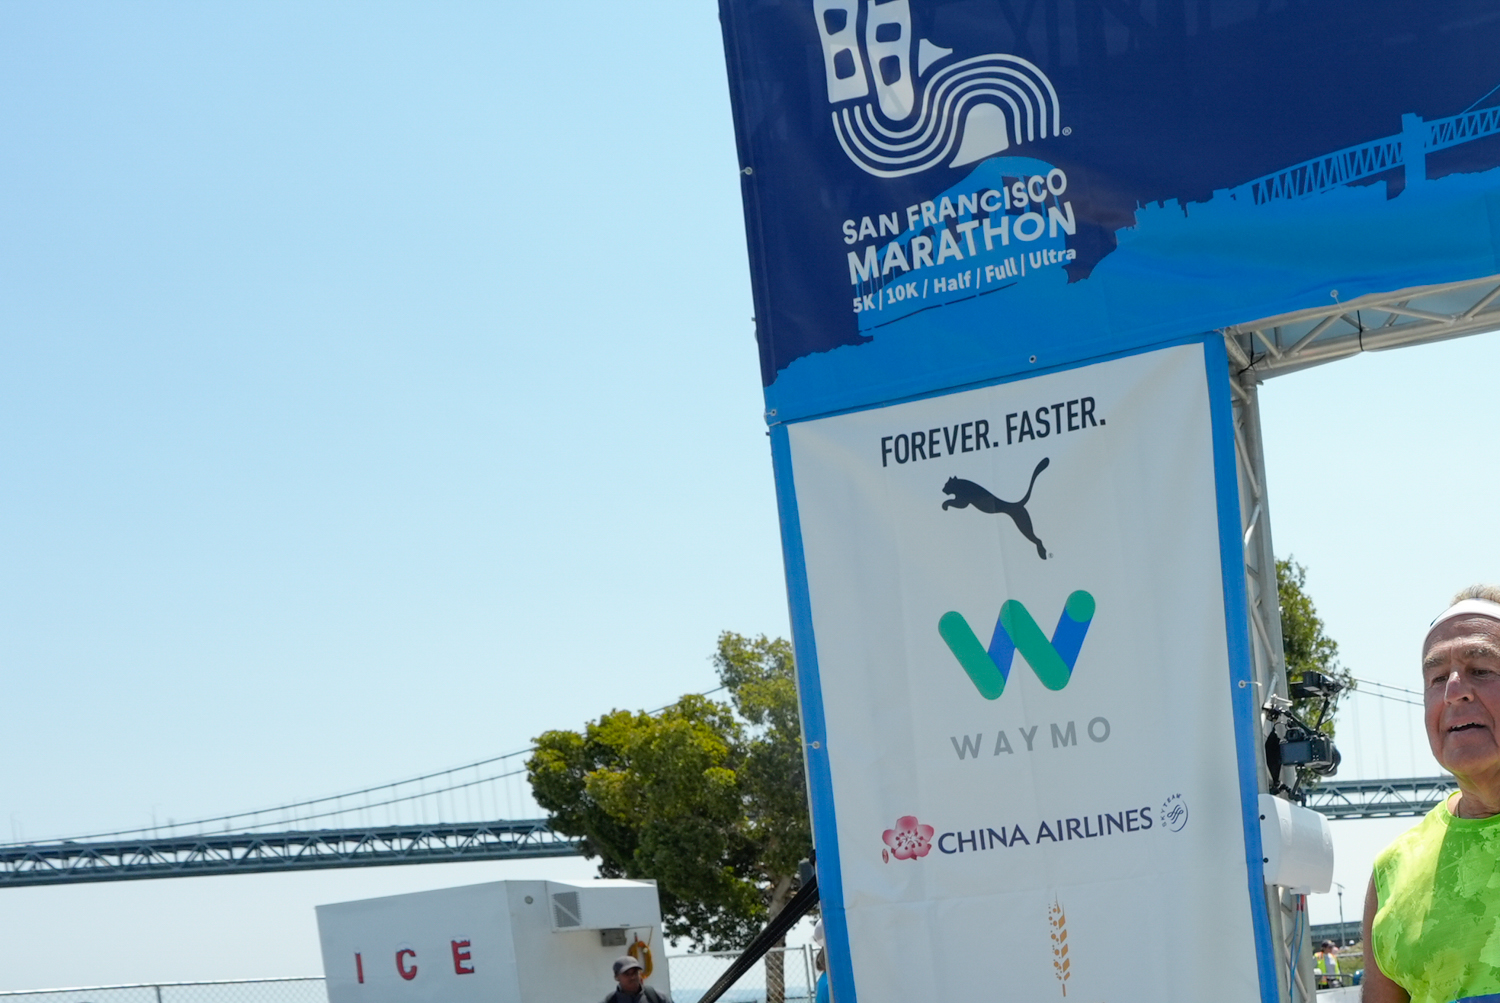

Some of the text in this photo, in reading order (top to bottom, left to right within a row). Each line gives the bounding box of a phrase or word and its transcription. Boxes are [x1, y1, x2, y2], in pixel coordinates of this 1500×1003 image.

[842, 168, 1067, 245] SAN FRANCISCO
[847, 202, 1076, 285] MARATHON
[852, 294, 875, 314] 5K
[886, 282, 919, 305] 10K
[933, 271, 972, 294] Half
[985, 260, 1018, 283] Full
[1029, 247, 1077, 271] Ultra
[881, 396, 1106, 467] FOREVER. FASTER.
[950, 716, 1111, 760] WAYMO
[937, 806, 1153, 854] CHINA AIRLINES
[353, 934, 475, 984] ICE
